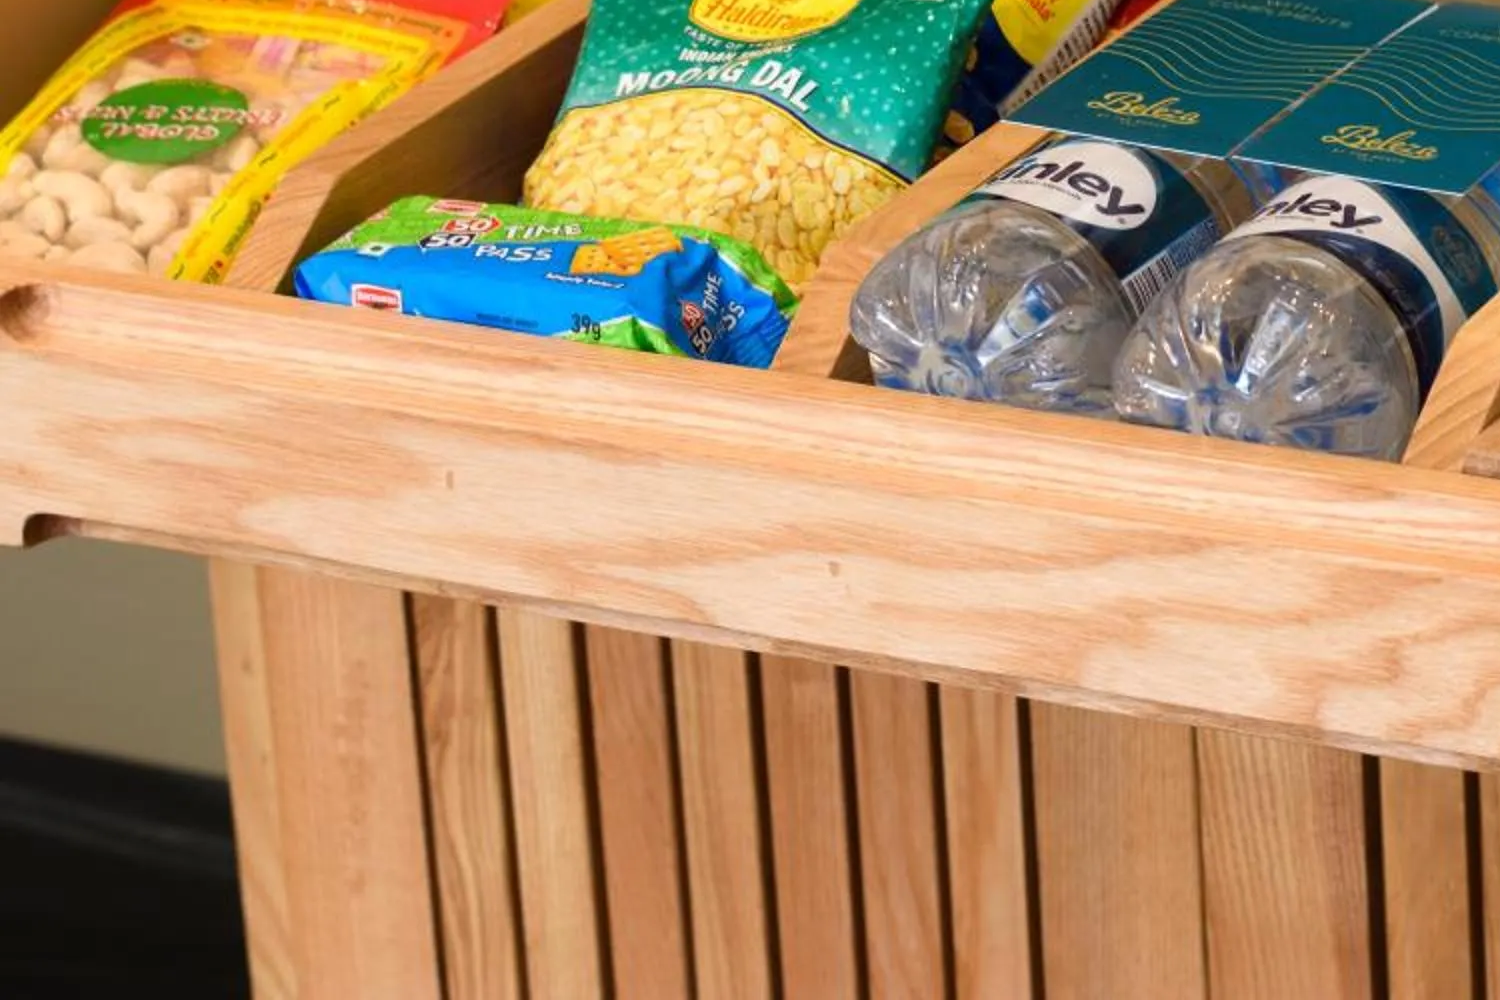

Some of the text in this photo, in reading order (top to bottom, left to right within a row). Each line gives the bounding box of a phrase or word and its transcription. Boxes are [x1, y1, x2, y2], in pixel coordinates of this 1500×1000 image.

[615, 59, 819, 112] MOONG DAL
[453, 216, 493, 231] 50
[1254, 192, 1383, 228] nley
[425, 233, 472, 248] 50
[504, 223, 583, 239] TIME
[474, 243, 554, 262] PASS
[703, 271, 723, 315] TIME
[571, 312, 602, 341] 39g
[692, 326, 713, 354] 50
